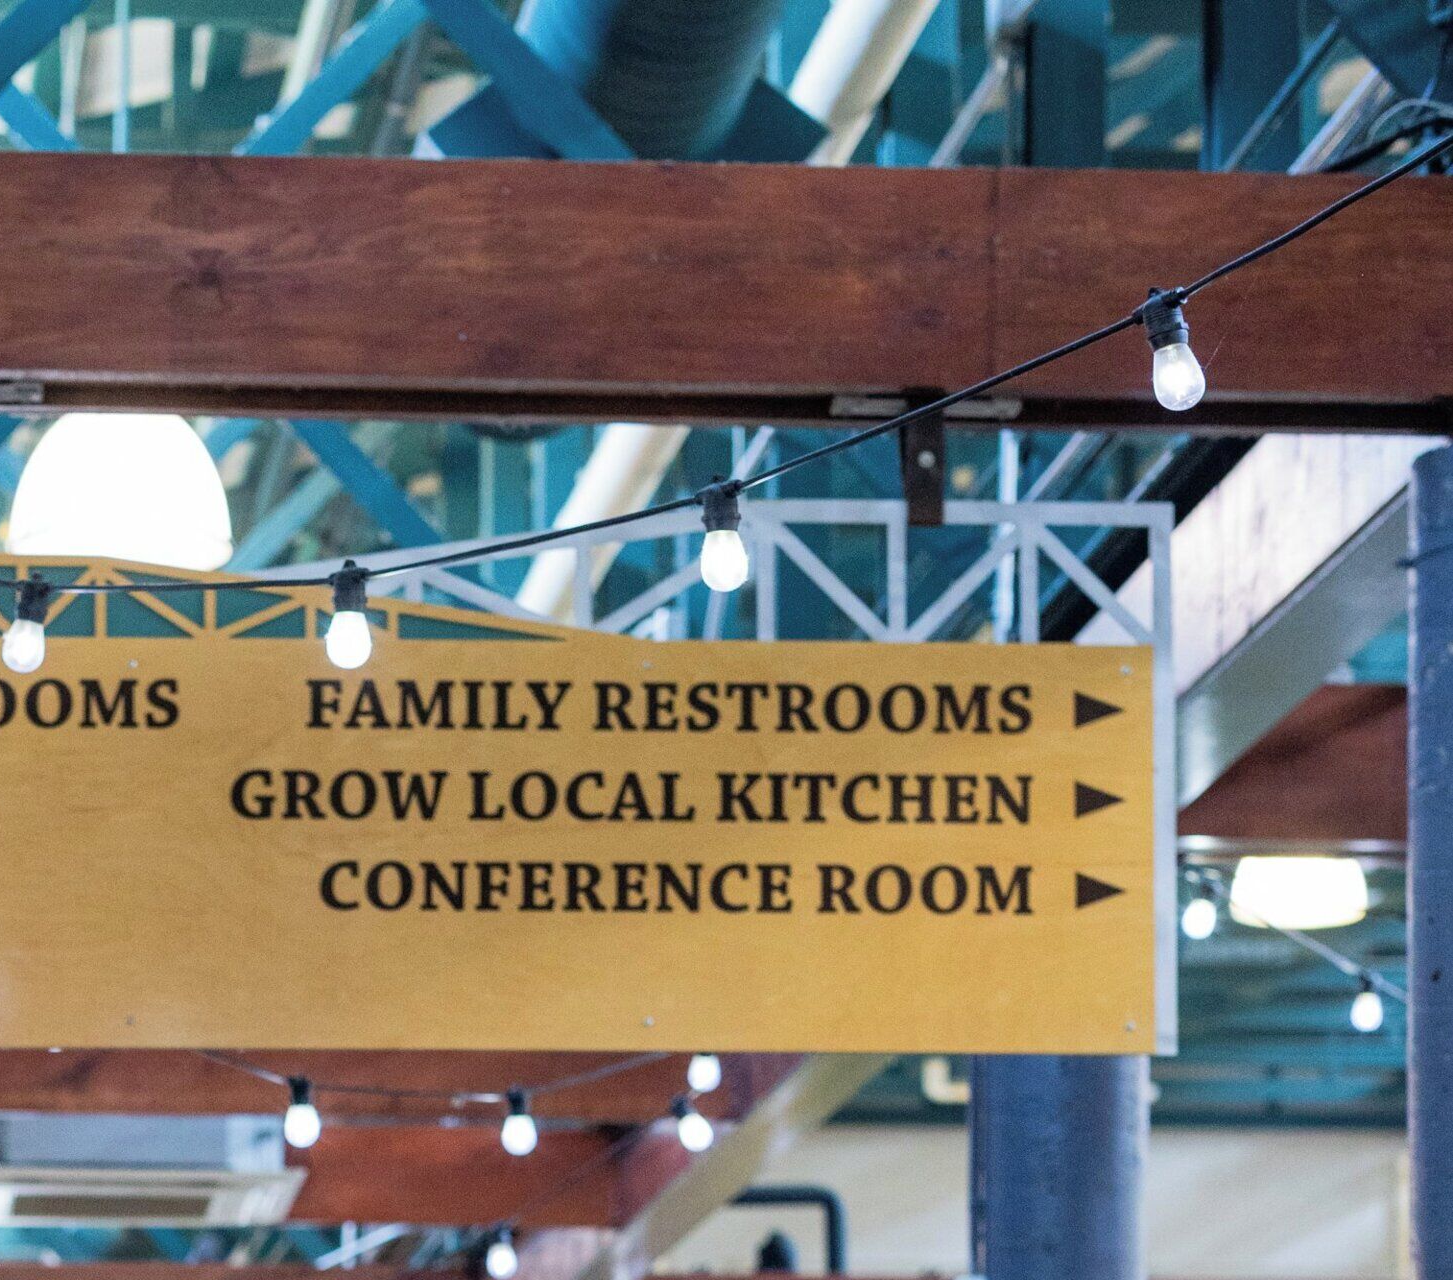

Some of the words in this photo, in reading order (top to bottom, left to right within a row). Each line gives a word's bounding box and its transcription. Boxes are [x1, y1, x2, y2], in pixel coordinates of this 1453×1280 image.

[305, 678, 574, 733] FAMILY
[591, 680, 1034, 736] RESTROOMS
[228, 767, 450, 823] GROW
[467, 769, 697, 824] LOCAL
[714, 770, 1033, 826] KITCHEN
[318, 859, 794, 914] CONFERENCE
[816, 863, 1034, 916] ROOM
